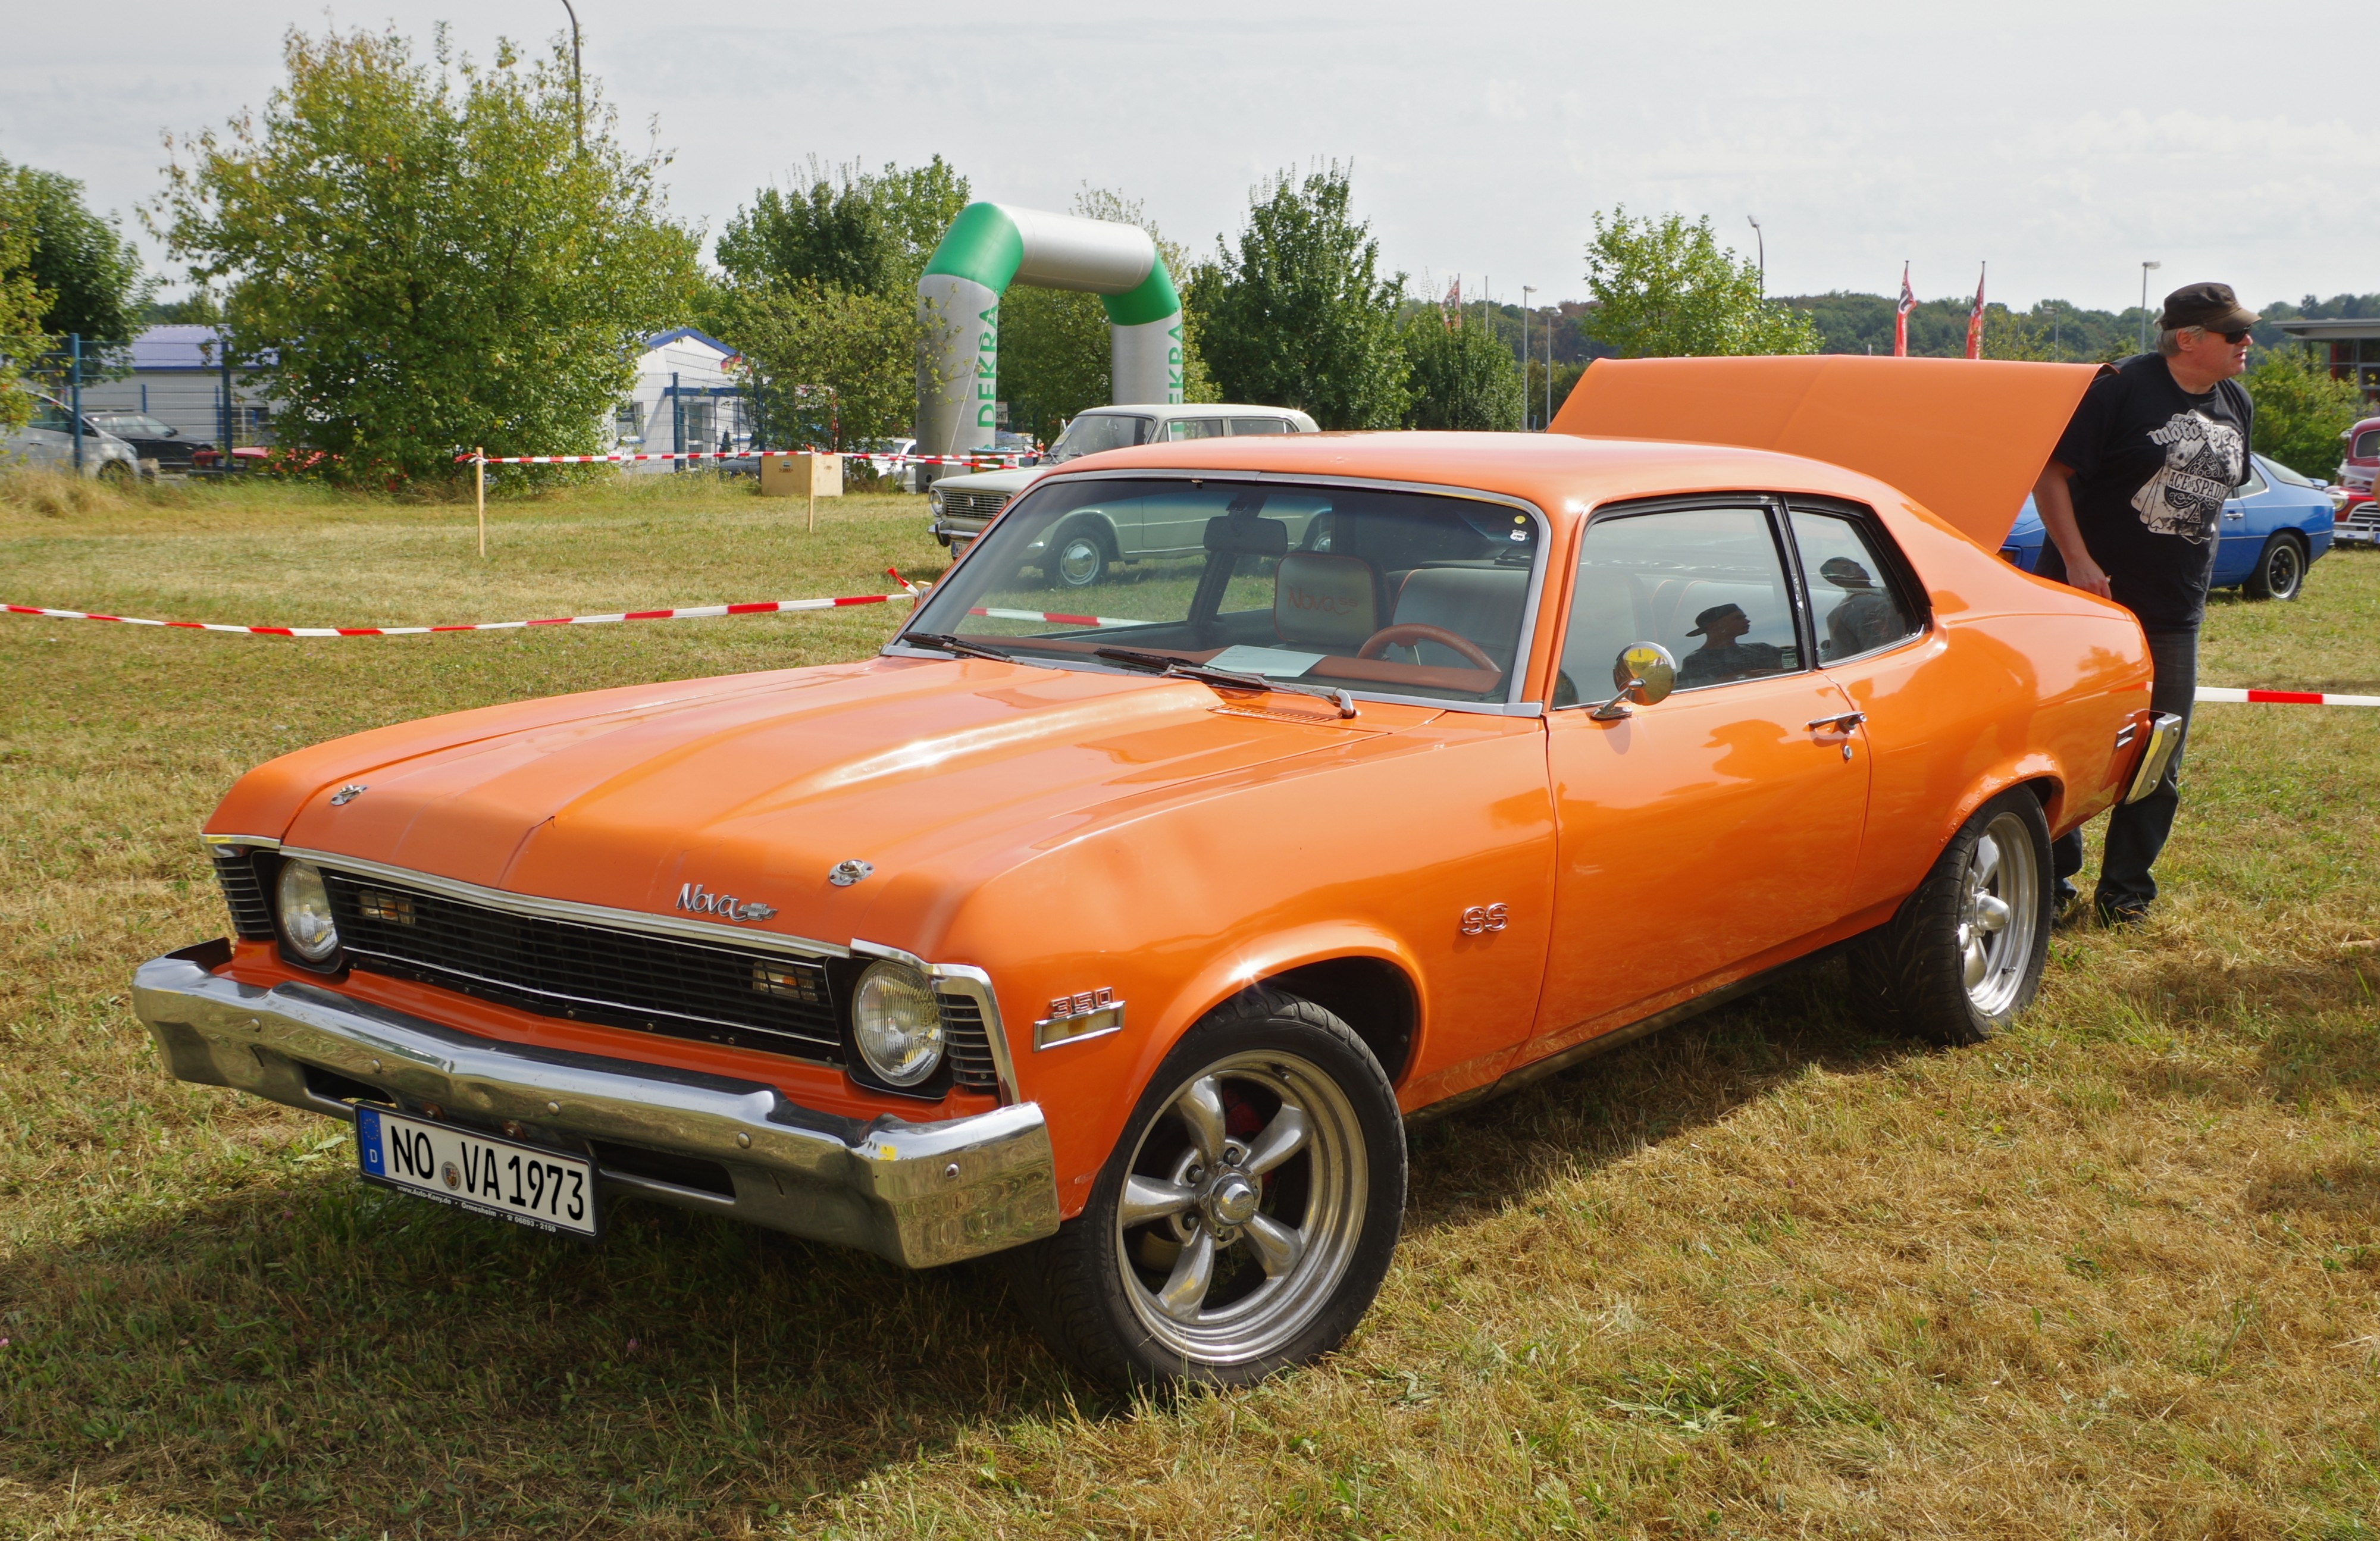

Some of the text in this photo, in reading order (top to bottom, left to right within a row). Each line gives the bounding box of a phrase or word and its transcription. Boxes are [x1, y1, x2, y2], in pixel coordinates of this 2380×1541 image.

[978, 305, 998, 427] DEKRA
[2169, 472, 2226, 500] ACE OF SPADE
[676, 883, 747, 922] Nova
[1461, 903, 1509, 935] SS
[1050, 986, 1114, 1019] 350
[369, 1148, 378, 1163] D
[461, 1202, 497, 1217] Ormesheim
[514, 1217, 535, 1227] 06893
[540, 1221, 556, 1233] 2159
